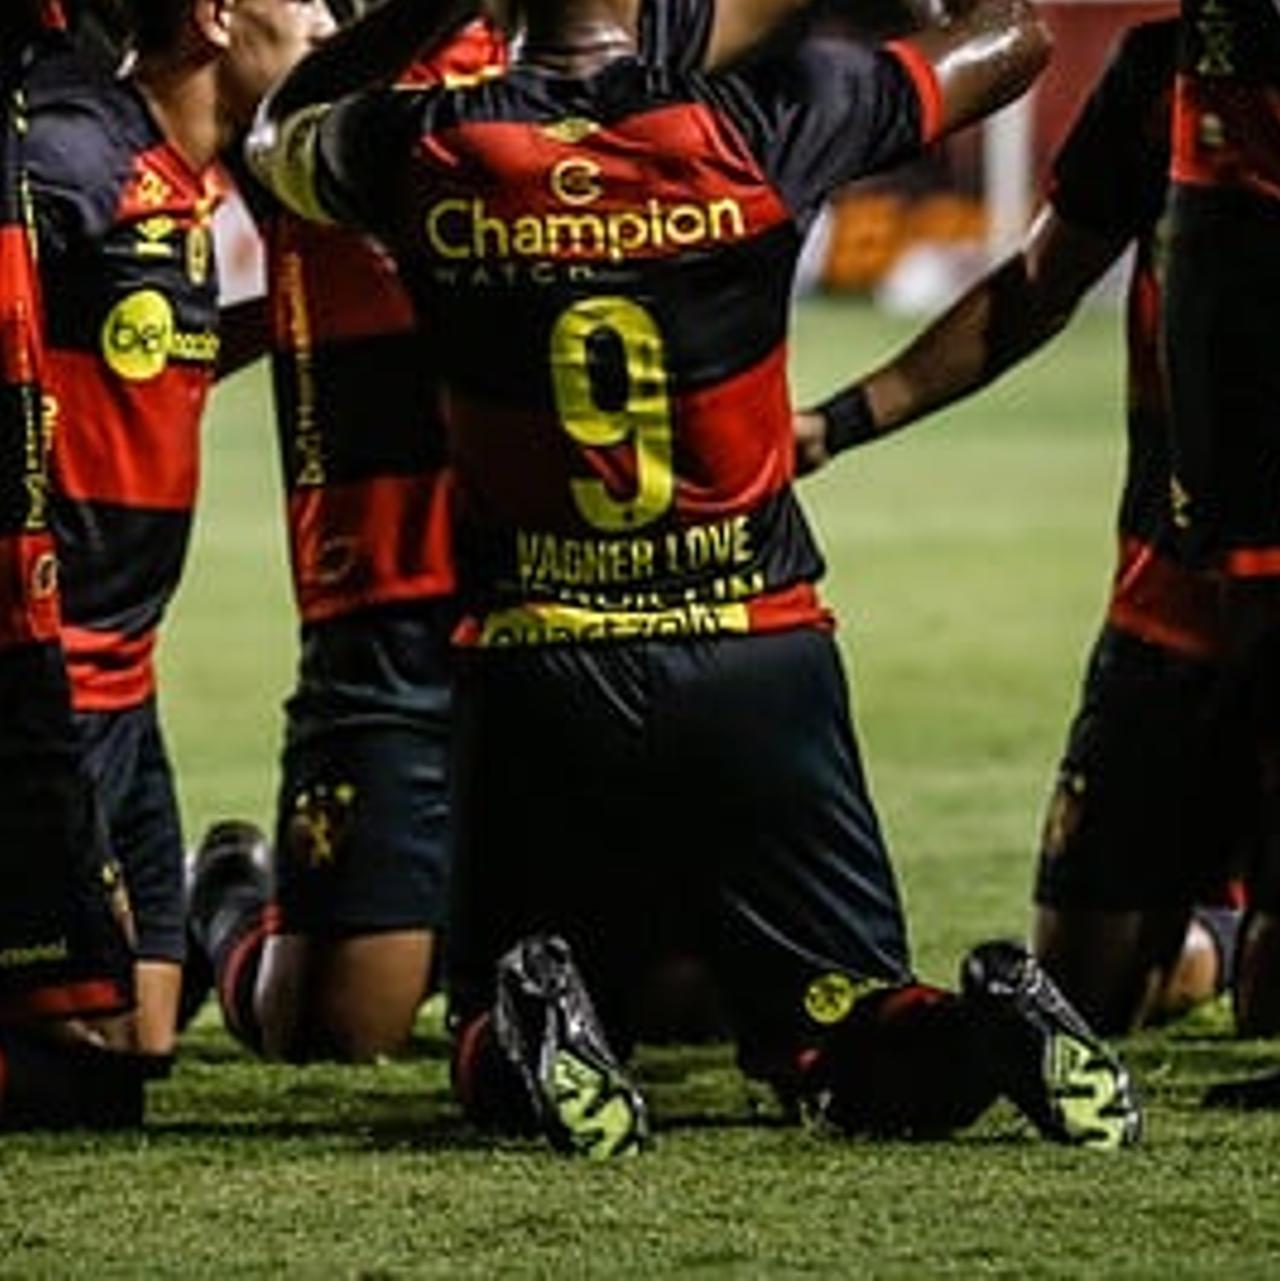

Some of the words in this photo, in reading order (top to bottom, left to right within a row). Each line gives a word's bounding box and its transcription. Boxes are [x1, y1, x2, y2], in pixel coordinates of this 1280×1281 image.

[426, 195, 746, 263] Champion
[551, 294, 673, 532] 9
[517, 531, 655, 586] VAGNER
[665, 515, 754, 572] LOVE
